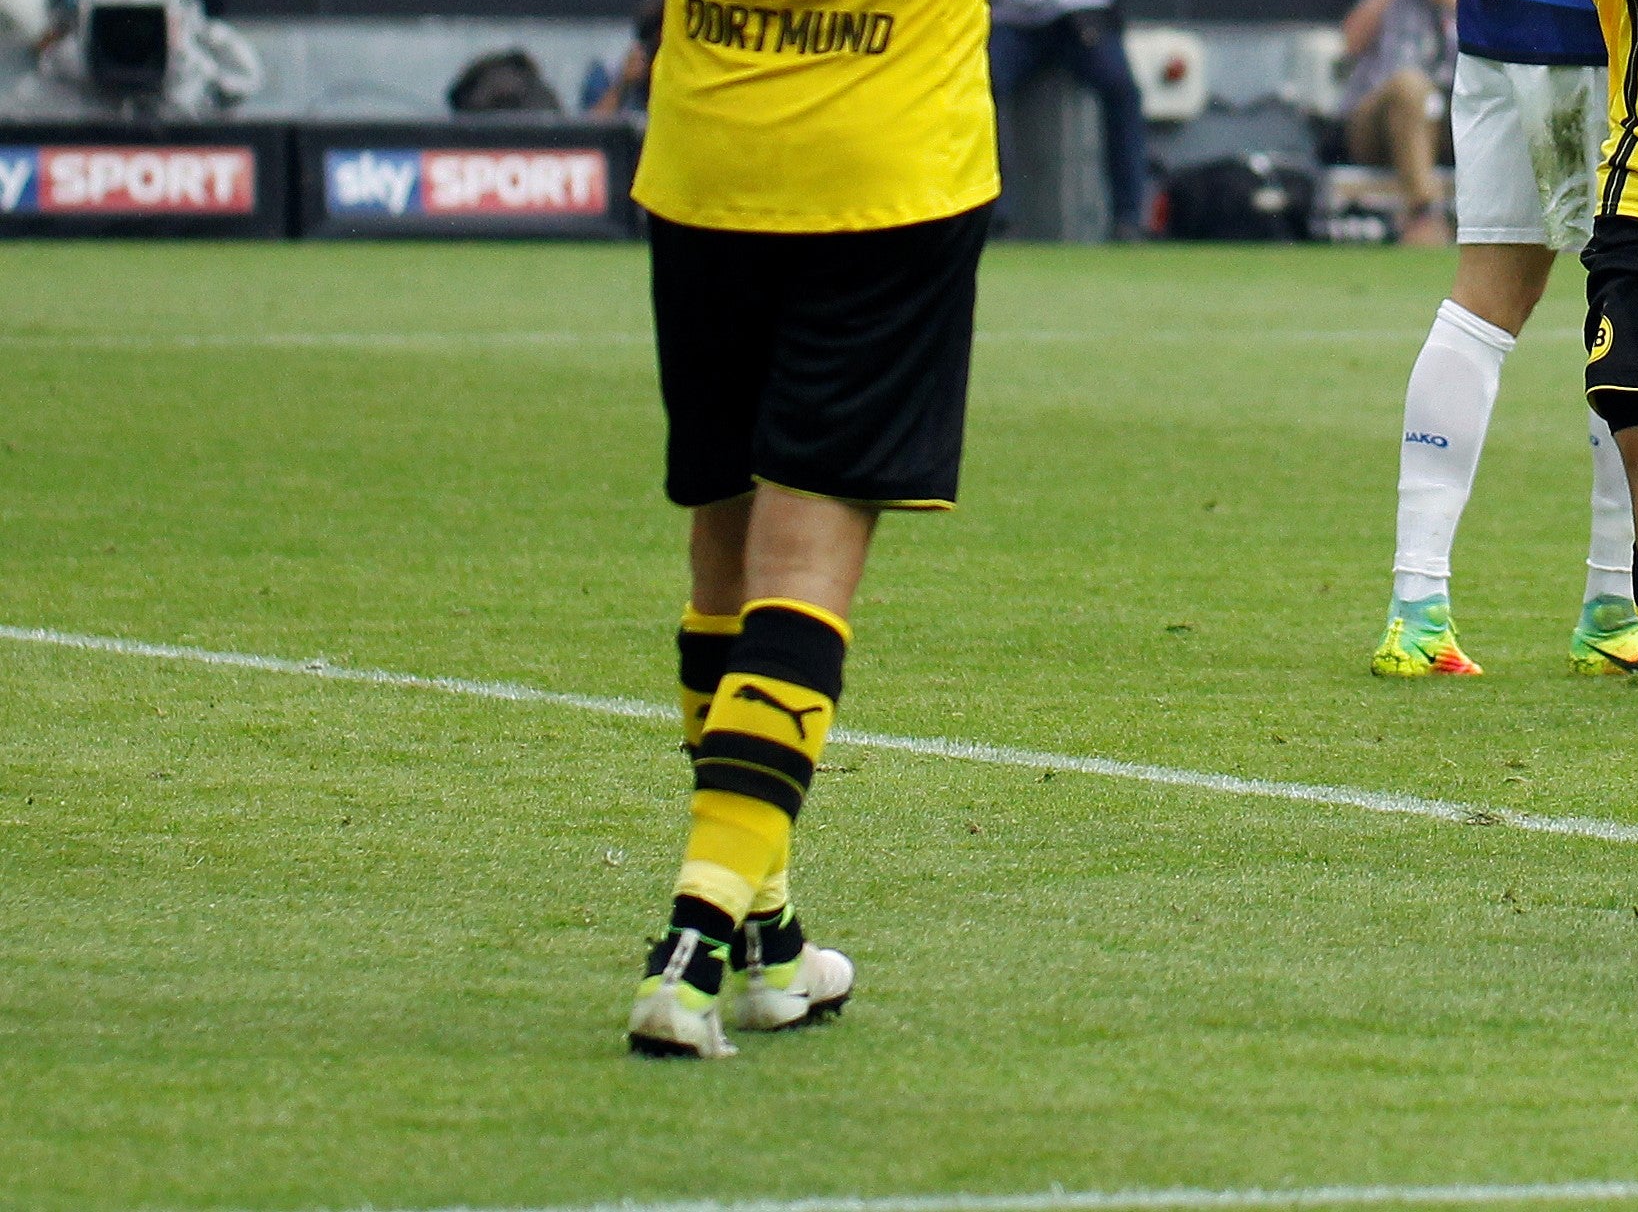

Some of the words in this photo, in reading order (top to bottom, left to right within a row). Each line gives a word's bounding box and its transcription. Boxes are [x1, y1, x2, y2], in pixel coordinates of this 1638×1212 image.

[50, 152, 249, 206] SPORT
[335, 150, 418, 215] sky
[430, 154, 602, 208] SPORT
